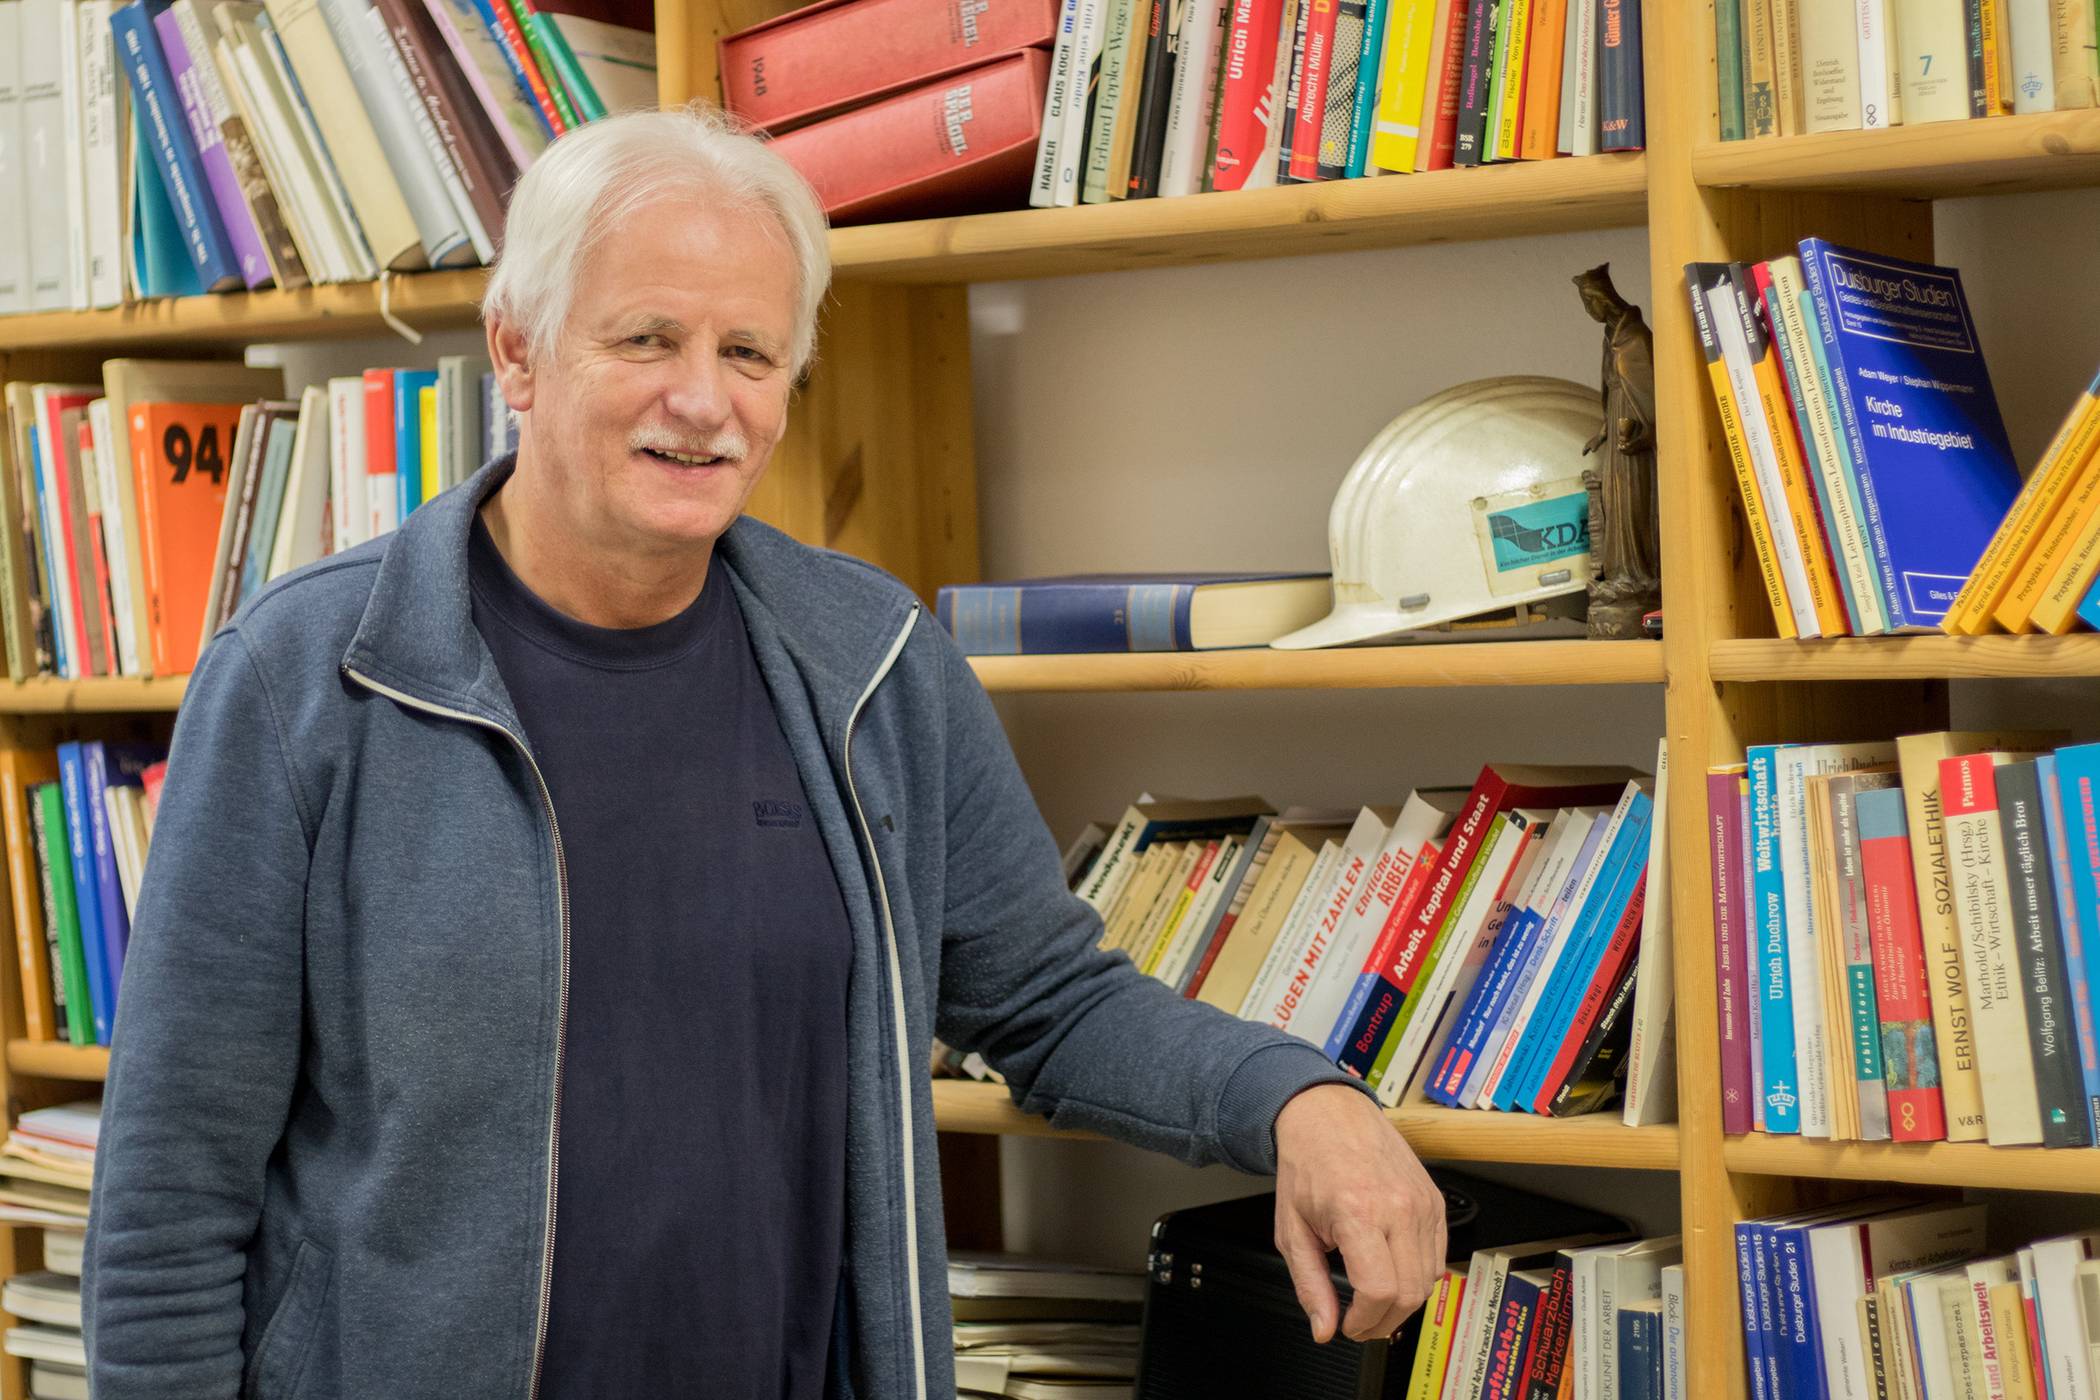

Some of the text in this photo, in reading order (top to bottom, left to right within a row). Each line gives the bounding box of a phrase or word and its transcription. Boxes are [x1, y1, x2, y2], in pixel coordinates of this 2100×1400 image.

[1474, 3, 1482, 17] die
[1227, 29, 1248, 79] Ulrich
[1308, 31, 1326, 69] Müller
[1469, 19, 1483, 57] Bedroht
[1511, 45, 1519, 61] Von
[750, 57, 769, 96] 1948
[1071, 69, 1085, 109] Kinder
[1090, 8, 1128, 172] Erhard Eppler Wege
[1286, 35, 1306, 109] Nieten in
[1507, 69, 1517, 98] Fischer
[1919, 55, 1932, 76] 7
[1041, 15, 1073, 190] HANSER CLAUS KOCH DIE
[1300, 72, 1319, 123] Albrecht
[1803, 249, 1834, 344] Duisburger Studien 15
[1833, 263, 1901, 297] Duisburger
[1901, 276, 1955, 307] Studien
[1688, 283, 1713, 347] SWI zum Thema
[1780, 273, 1818, 392] Lebensmöglichkeiten
[1816, 365, 1834, 409] Production
[1833, 367, 1855, 425] Industriegebiet
[1859, 367, 1880, 380] Adam
[1879, 371, 1898, 385] Weyer
[1904, 375, 1933, 389] Stephan
[1717, 394, 1735, 430] KIRCHE
[1847, 426, 1857, 437] im
[1865, 396, 1902, 419] Kirche
[1728, 433, 1747, 475] TECHNIK
[1809, 391, 1839, 476] Lebensformen,
[1850, 438, 1864, 463] Kirche
[1871, 419, 1974, 450] im Industriegebiet
[1740, 479, 1758, 515] MEDIEN
[1829, 475, 1859, 560] Lebensphasen,
[1858, 473, 1878, 523] Wippermann
[1870, 524, 1886, 558] Stephan
[1763, 562, 1782, 607] Christiane
[1880, 564, 1894, 590] Weyer
[1886, 590, 1900, 615] Adam
[1956, 759, 1975, 807] Patmos
[1749, 757, 1773, 872] Weltwirtschaft
[1837, 792, 1854, 876] Leben ist mehr als Kapital
[1085, 821, 1138, 901] Wendepunkt
[1352, 849, 1392, 917] Ehrliche
[1374, 846, 1414, 907] ARBEIT
[1713, 814, 1726, 903] MARKTWIRTSCHAFT
[1390, 924, 1427, 979] Arbeit,
[1417, 868, 1455, 925] Kapital
[1445, 835, 1472, 870] und
[1461, 793, 1493, 837] Staat
[1974, 818, 2008, 1000] Ethik Wirtschaft Kirche
[1718, 905, 1727, 920] DIE
[1718, 922, 1728, 941] UND
[1921, 789, 1973, 1071] ERNST WOLF SOZIALETHIK
[1958, 820, 1993, 1010] Marhold/Schibilsky (Hrsg.)
[2011, 799, 2057, 1056] Wolfgang Belitz: Arbeit unser täglich Brot
[1267, 855, 1368, 1031] LÜGEN MIT ZAHLEN
[1719, 943, 1730, 970] JESUS
[1765, 891, 1784, 999] Ulrich Duchrow
[1587, 982, 1603, 1002] Negt
[1352, 991, 1398, 1054] Bontrup
[1958, 1115, 1983, 1126] V&R
[1602, 1288, 1615, 1324] ARBEIT
[1737, 1233, 1757, 1331] Duisburger Studien 15
[1752, 1233, 1773, 1331] Duisburger Studien 15
[1785, 1241, 1806, 1342] Duisburger Studien 21
[1471, 1270, 1505, 1383] Arbeit braucht der Mensch?
[1529, 1267, 1567, 1380] Schwarzbuch
[1668, 1293, 1679, 1323] Block:
[1501, 1304, 1528, 1396] der sozialen Krise
[1601, 1328, 1614, 1349] DER
[1669, 1327, 1679, 1345] Der
[1971, 1281, 1999, 1390] und Arbeitswelt
[1424, 1351, 1436, 1376] ARBEIT
